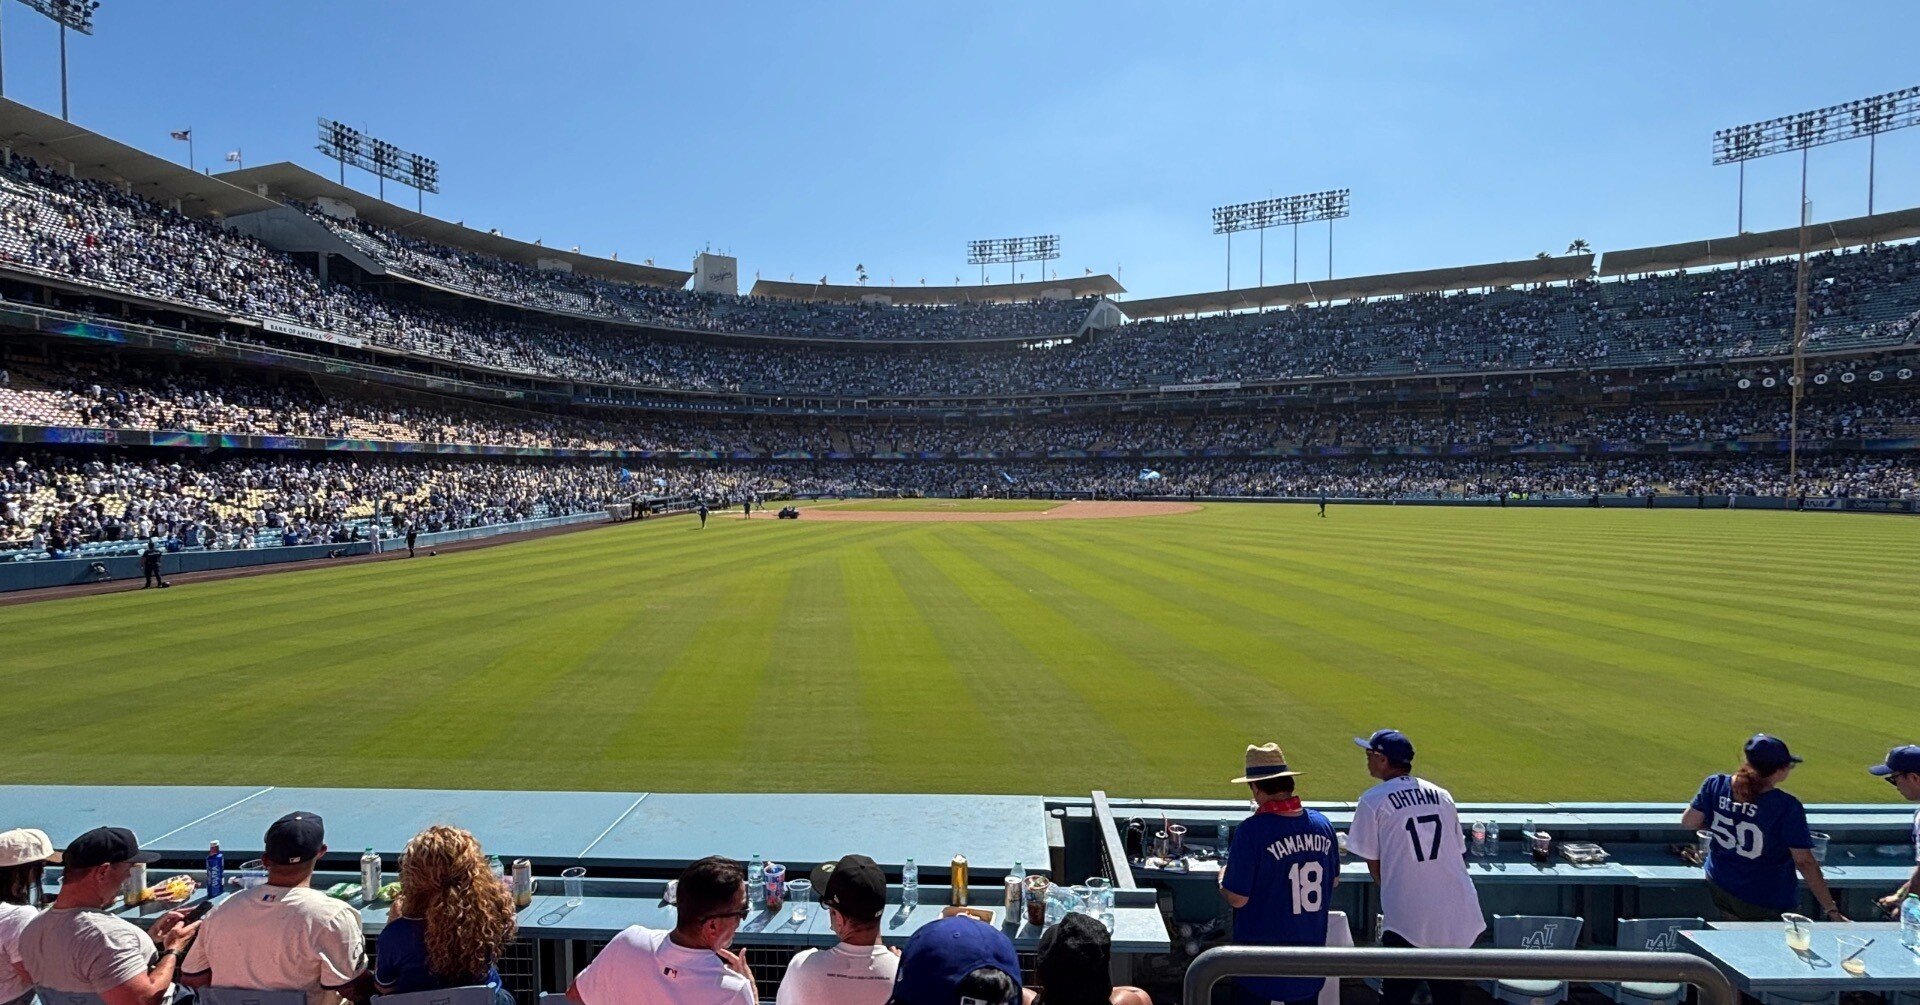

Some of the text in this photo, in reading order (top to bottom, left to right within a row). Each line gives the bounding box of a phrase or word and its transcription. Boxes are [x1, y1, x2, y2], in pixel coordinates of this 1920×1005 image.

[270, 324, 287, 333] BANK
[297, 330, 322, 339] AMERICA
[1388, 788, 1440, 810] OHTANI
[1266, 834, 1332, 861] YAMAMOTO
[1405, 814, 1443, 862] 17
[1710, 811, 1764, 860] 50
[1288, 861, 1324, 915] 18
